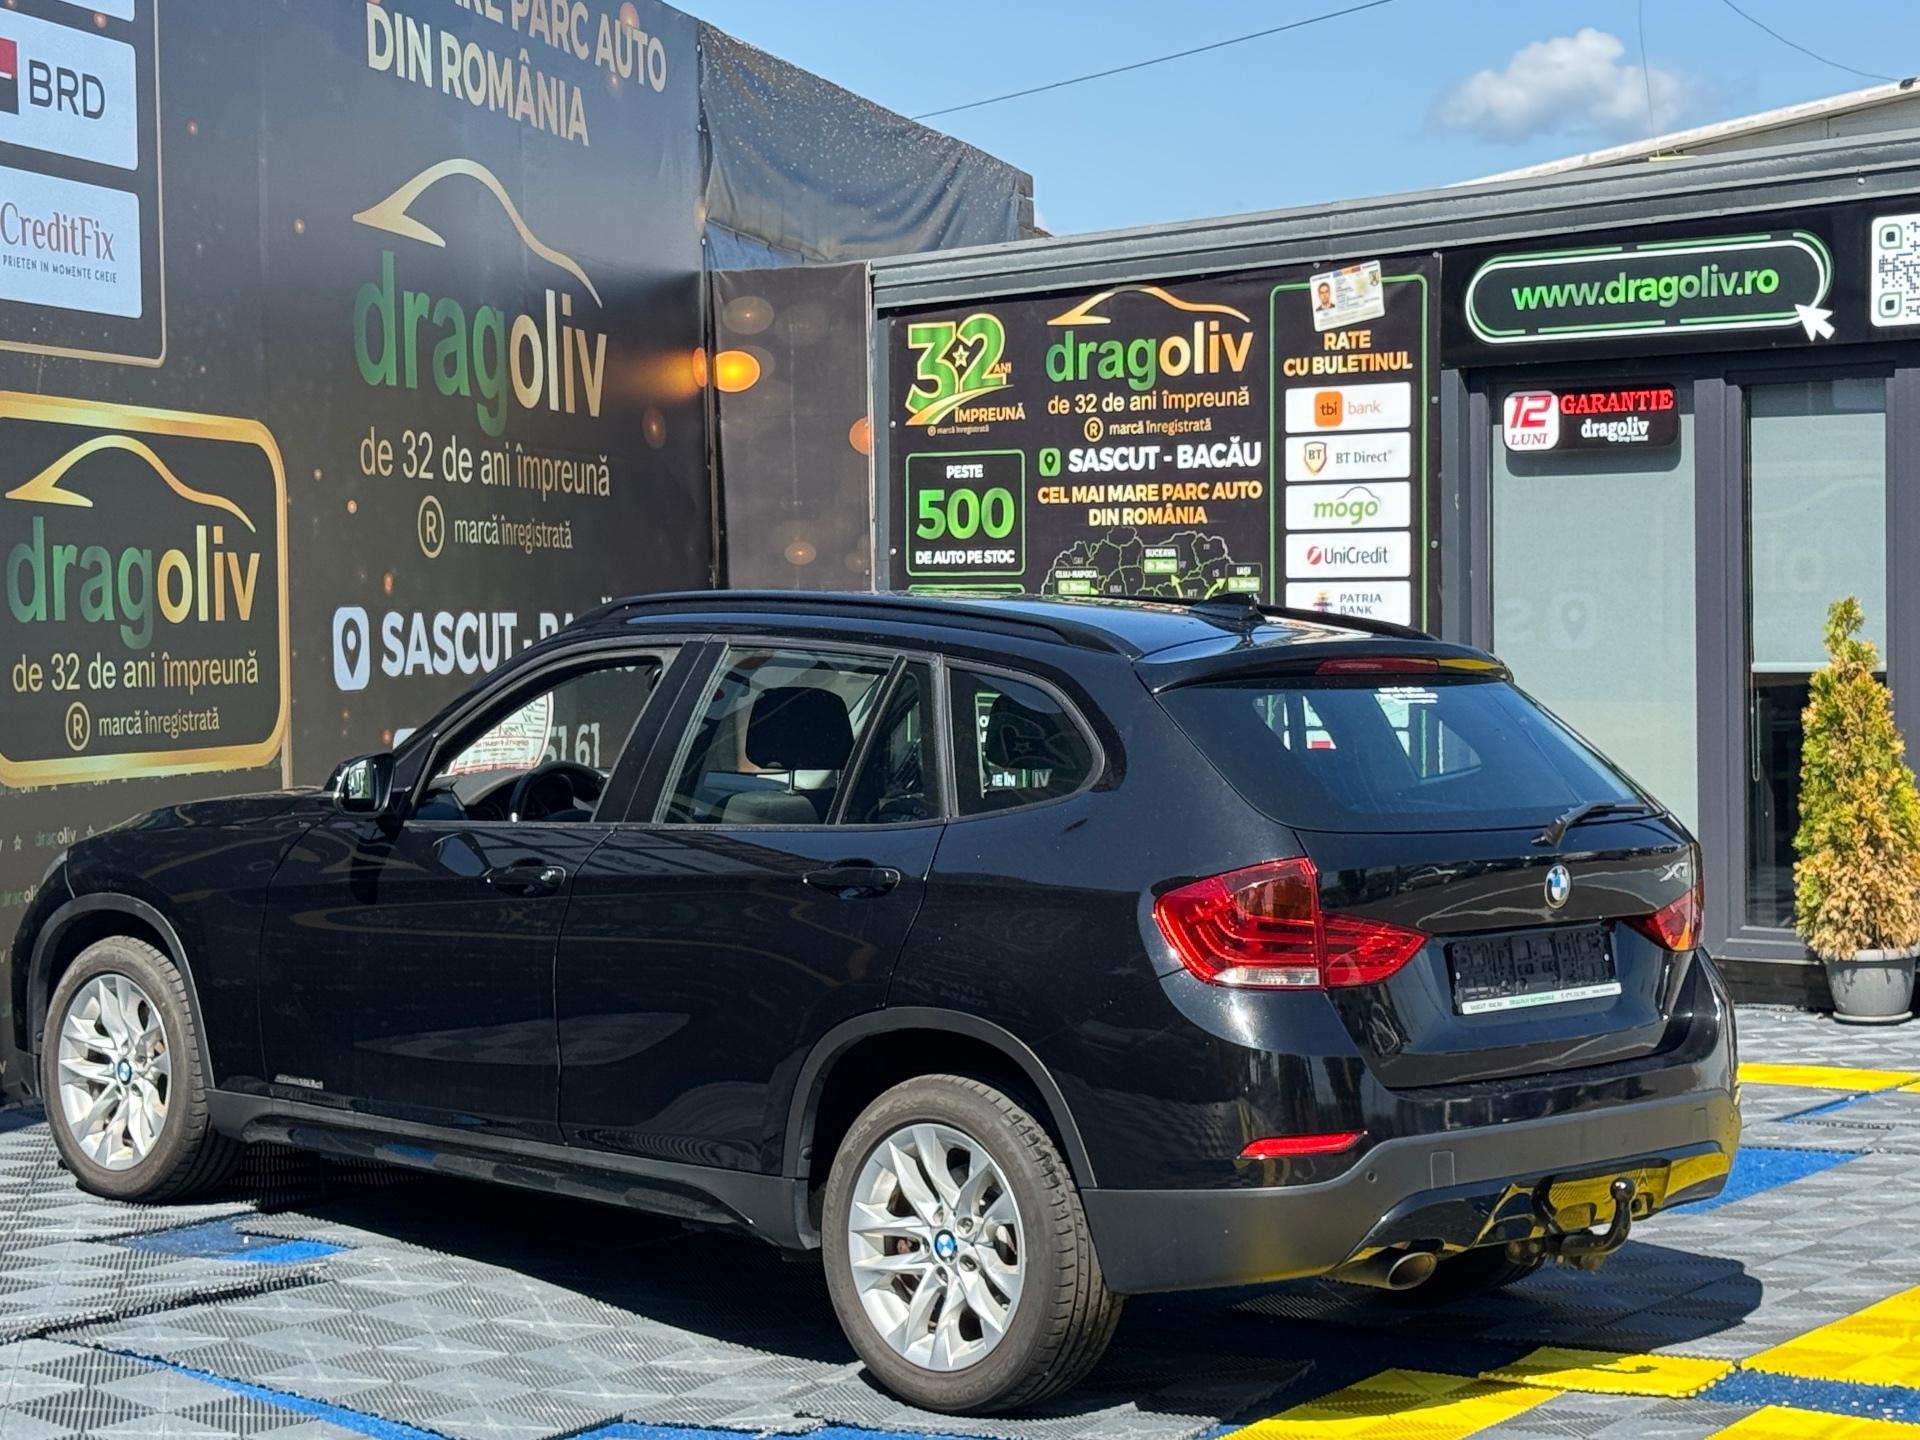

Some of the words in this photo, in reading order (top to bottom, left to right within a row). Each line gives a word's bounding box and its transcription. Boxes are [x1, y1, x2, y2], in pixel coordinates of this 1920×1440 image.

[511, 0, 589, 60] PARC
[595, 13, 667, 93] AUTO
[366, 3, 433, 88] DIN
[440, 30, 589, 146] ROMÂNIA
[29, 59, 105, 120] BRD
[0, 201, 116, 262] CreditFix
[2, 254, 37, 269] PRIETEN
[40, 260, 49, 272] IN
[52, 263, 92, 280] MOMENTE
[94, 269, 118, 284] CHEIE
[1511, 263, 1780, 311] www.dragoliv.ro
[353, 250, 608, 437] dragoliv
[1323, 330, 1372, 351] RATE
[905, 313, 1006, 414] 32
[993, 361, 1012, 374] ANI
[1046, 320, 1254, 391] dragoliv
[1283, 357, 1309, 377] CU
[1312, 351, 1413, 375] BULETINUL
[954, 402, 1026, 423] ÎMPREUNĂ
[1047, 395, 1070, 415] de
[1075, 393, 1098, 413] 32
[1101, 392, 1125, 413] de
[1129, 390, 1157, 411] ani
[1161, 386, 1250, 413] împreună
[1320, 401, 1338, 416] tbi
[1347, 401, 1382, 416] bank
[1510, 395, 1552, 429] 12
[1560, 389, 1674, 415] GARANTIE
[1109, 420, 1145, 436] marcă
[1146, 417, 1212, 436] înregistrată
[1510, 433, 1549, 446] LUNI
[1580, 416, 1650, 442] dragoliv
[360, 426, 394, 476] de
[402, 429, 434, 480] 32
[442, 435, 473, 484] de
[480, 443, 511, 487] ani
[516, 445, 610, 501] împreună
[1068, 446, 1161, 473] SASCUT
[1176, 436, 1262, 469] BACĂU
[1309, 449, 1322, 459] BT
[1335, 452, 1351, 464] BT
[946, 464, 984, 479] PESTE
[1037, 486, 1069, 504] CEL
[1071, 485, 1105, 503] MAI
[1108, 484, 1160, 502] MARE
[1162, 482, 1210, 501] PARC
[1212, 480, 1263, 500] AUTO
[916, 487, 1015, 540] 500
[1088, 507, 1120, 526] DIN
[1122, 502, 1208, 526] ROMÂNIA
[1313, 501, 1379, 525] mogo
[454, 514, 500, 545] marcă
[501, 514, 574, 554] înregistrată
[915, 550, 932, 565] DE
[933, 550, 966, 565] AUTO
[967, 550, 983, 564] PE
[983, 550, 1015, 564] STOC
[1324, 546, 1388, 564] UniCredit
[6, 516, 261, 649] dragoliv
[1339, 593, 1383, 604] PATRIA
[1339, 604, 1373, 616] BANK
[381, 611, 517, 677] SASCUT
[12, 654, 43, 692] de
[51, 653, 81, 690] 32
[88, 651, 117, 689] de
[123, 651, 156, 689] ani
[163, 649, 259, 695] împreună
[98, 709, 142, 736] marcă
[144, 707, 220, 738] înregistrată
[575, 722, 601, 768] 61
[1659, 861, 1690, 883] X1
